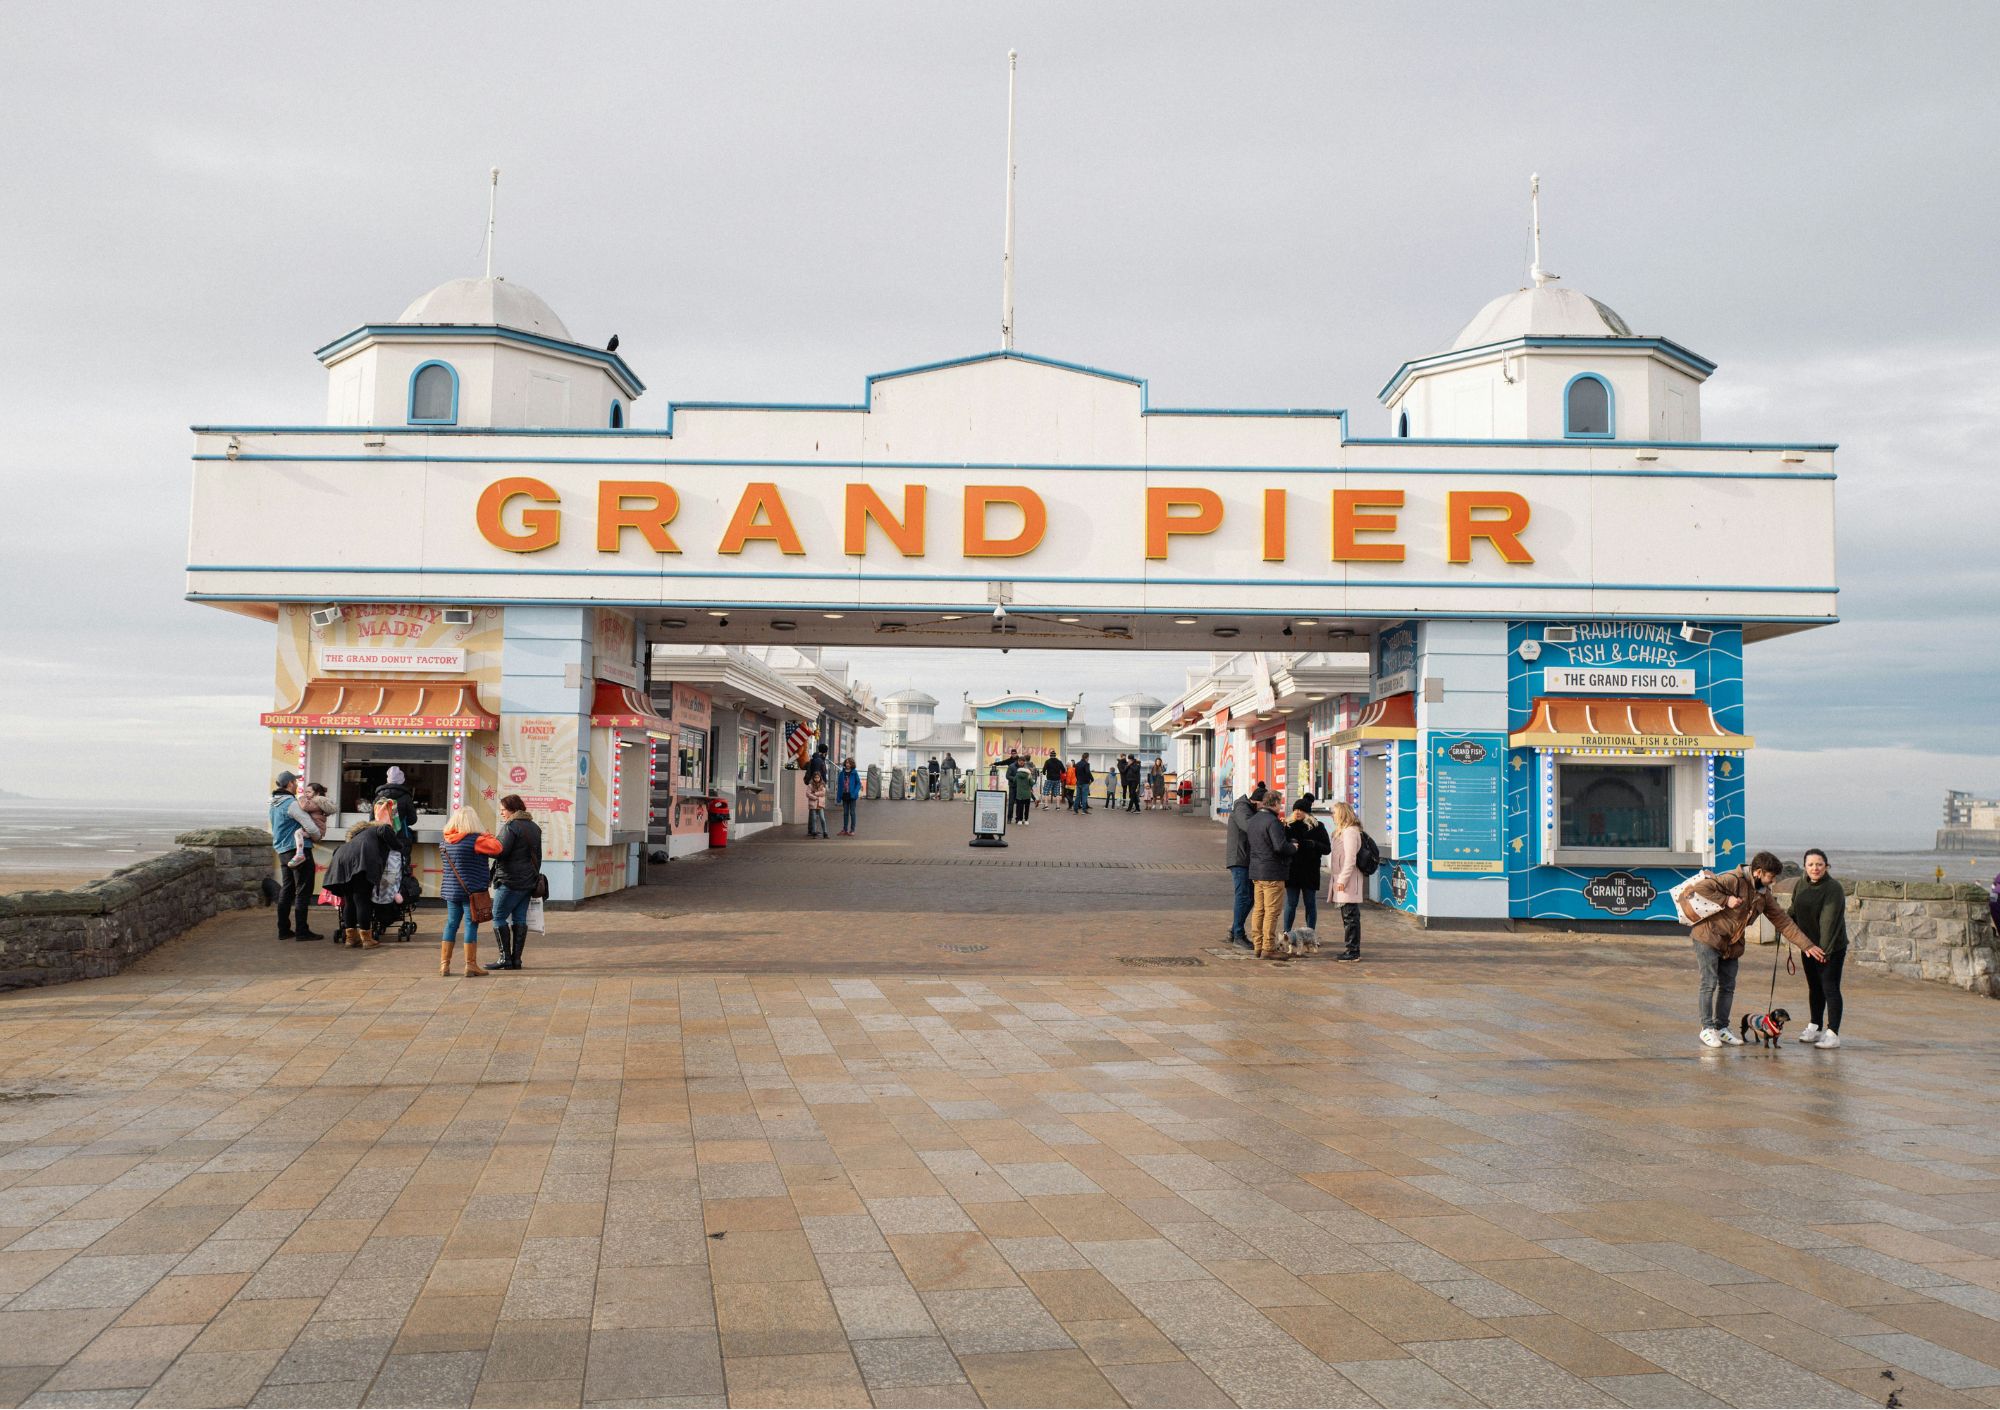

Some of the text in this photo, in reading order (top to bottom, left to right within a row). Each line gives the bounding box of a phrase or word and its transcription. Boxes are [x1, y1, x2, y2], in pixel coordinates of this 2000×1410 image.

[475, 476, 1535, 565] GRAND PIER
[340, 603, 442, 625] FRESHLY
[357, 620, 424, 639] MADE
[325, 654, 459, 665] THE GRAND DONUT FACTORY
[1567, 643, 1678, 668] FISH & CHIPS
[1563, 673, 1679, 688] THE GRAND FISH CO.
[264, 716, 309, 725] DONUTS
[319, 716, 361, 726] CREPES
[372, 717, 424, 727] WAFFLES
[435, 718, 476, 728] COFFEE
[521, 726, 556, 735] DONUT
[1581, 736, 1699, 747] TRADITIONAL FISH & CHIPS
[1614, 878, 1627, 886] THE
[1592, 885, 1648, 897] GRAND FISH
[1616, 897, 1627, 905] CO.
